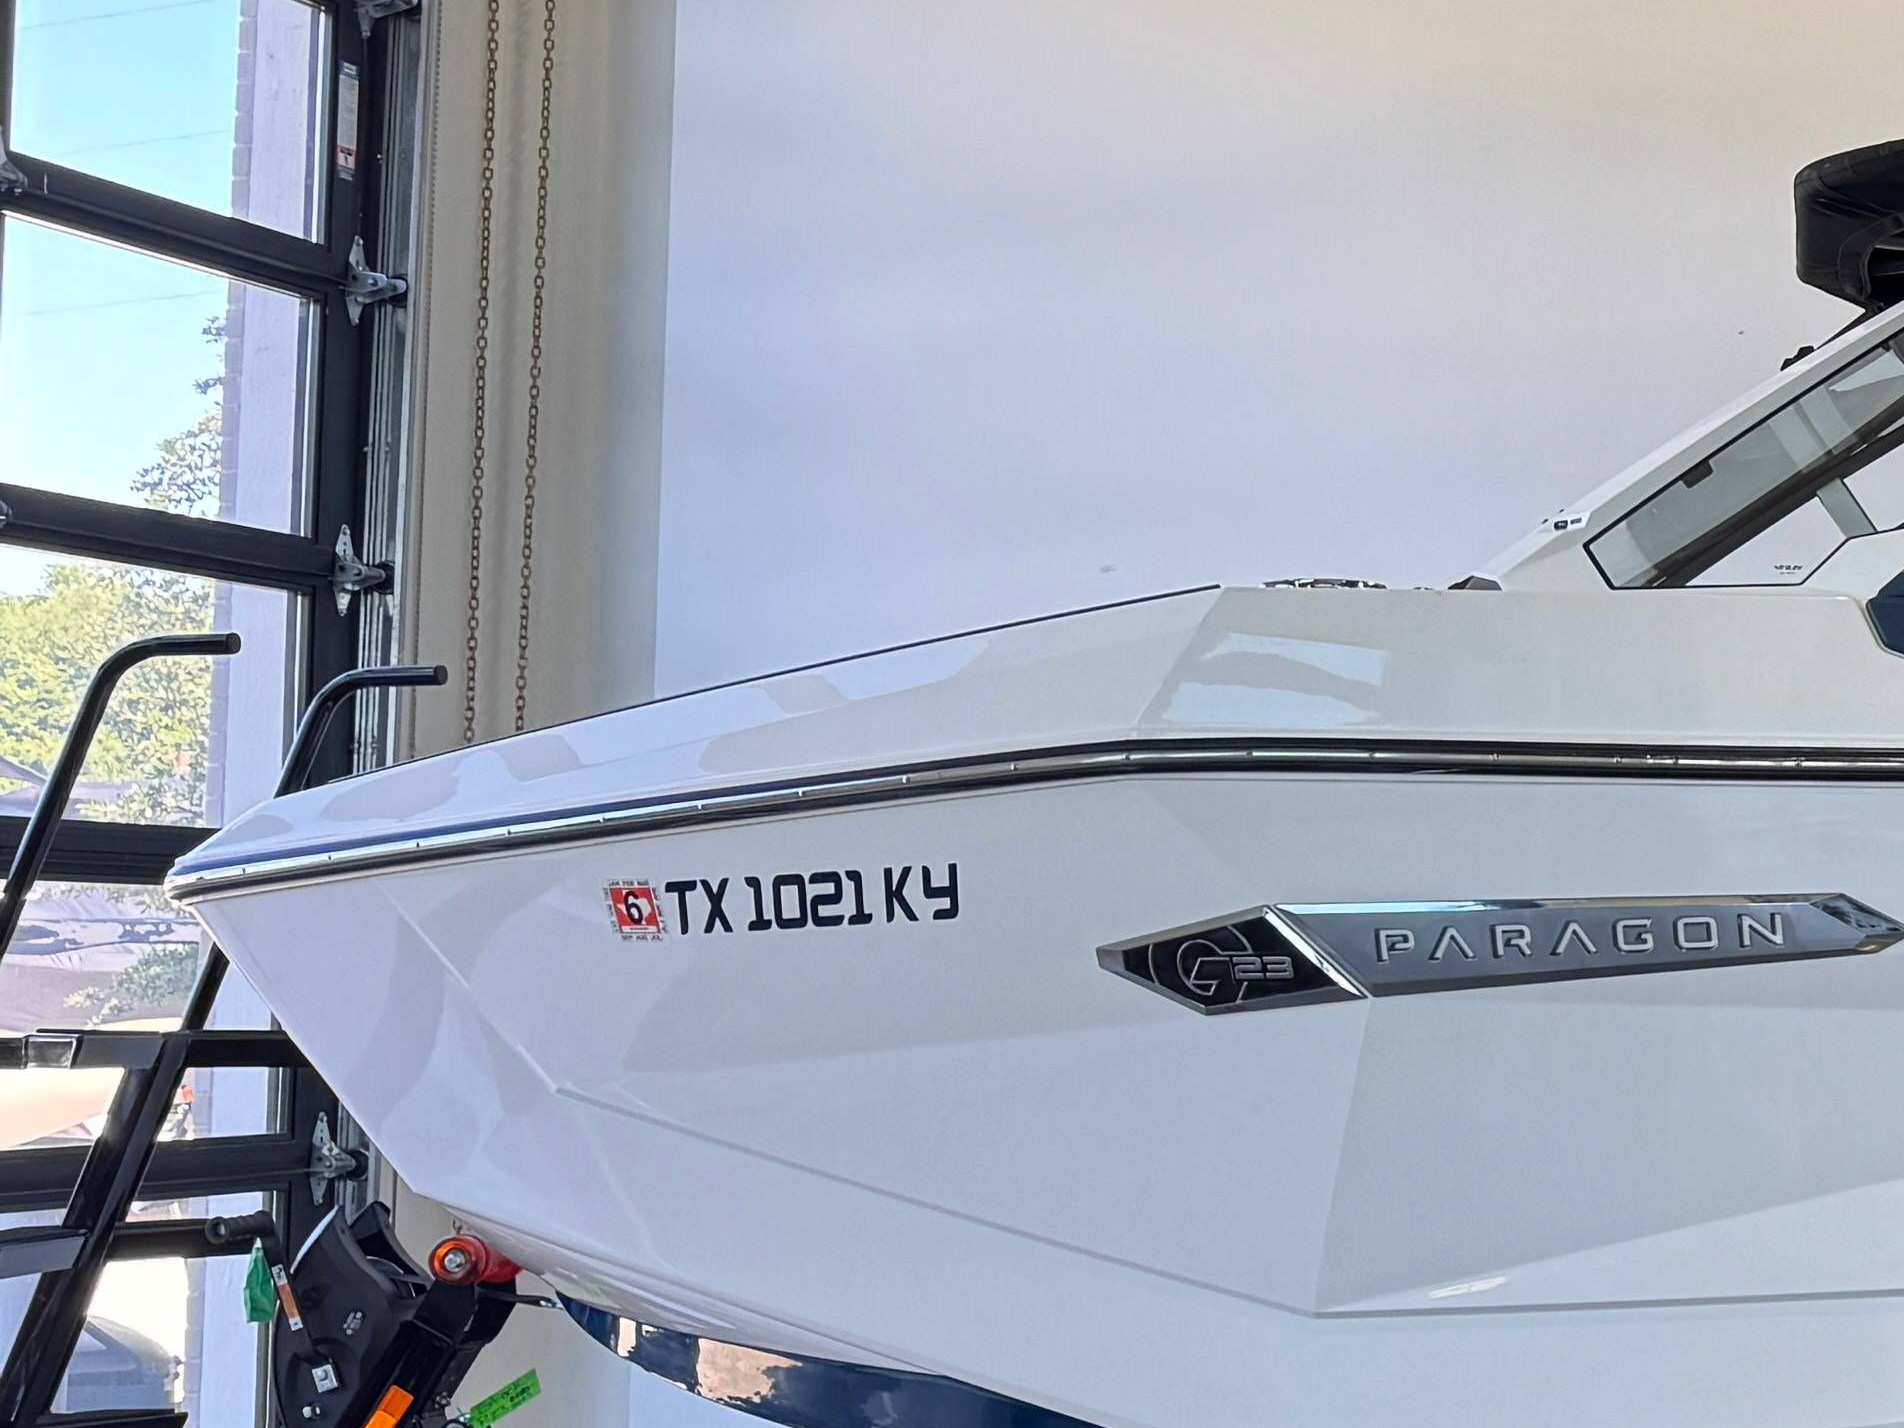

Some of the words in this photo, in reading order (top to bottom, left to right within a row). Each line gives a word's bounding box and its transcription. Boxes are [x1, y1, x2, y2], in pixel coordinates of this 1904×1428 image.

[623, 890, 643, 925] 6
[665, 877, 734, 935] TX
[743, 869, 873, 932] 1021
[883, 863, 959, 923] KY
[1375, 912, 1785, 963] PARAGON
